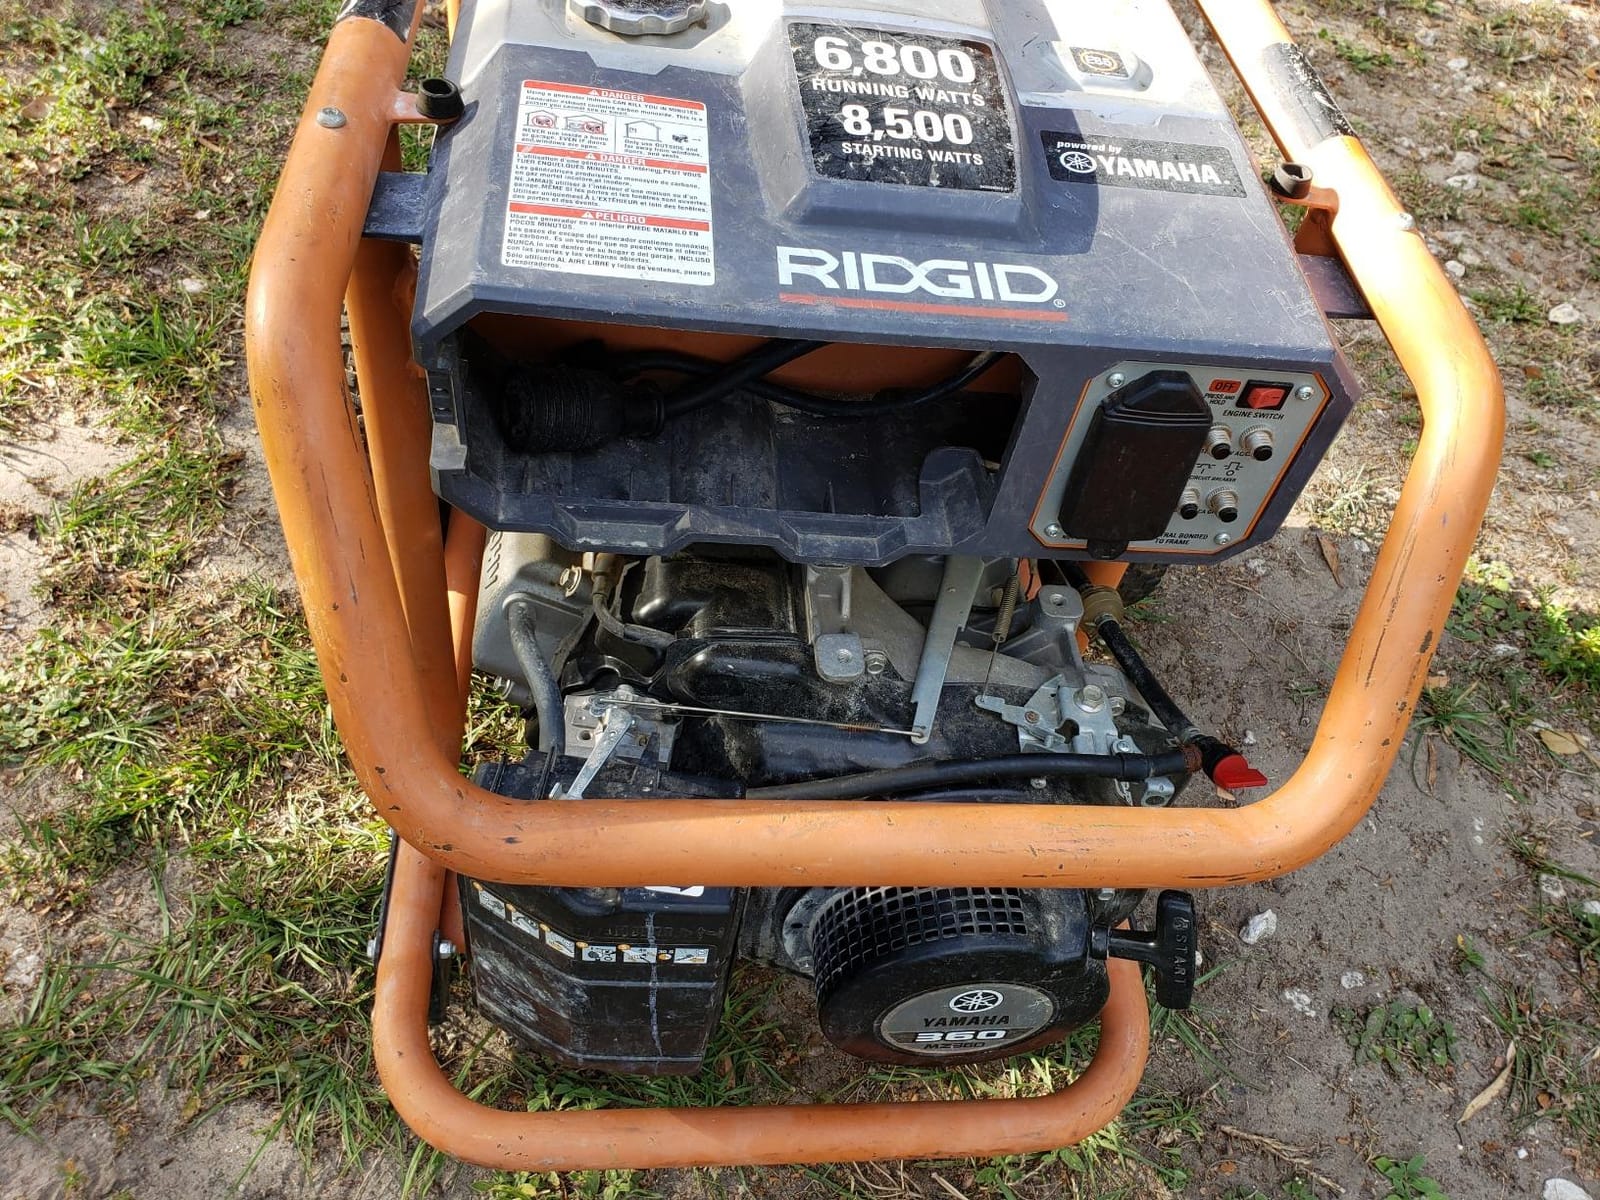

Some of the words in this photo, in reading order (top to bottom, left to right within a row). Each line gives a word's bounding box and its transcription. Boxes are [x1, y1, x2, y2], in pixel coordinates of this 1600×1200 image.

[814, 36, 976, 84] 6,800
[601, 90, 644, 102] DANGER
[812, 77, 910, 99] RUNNING
[915, 86, 986, 107] WATTS
[841, 104, 974, 146] 8,500
[841, 141, 927, 162] STARTING
[930, 147, 984, 167] WATTS
[1056, 139, 1105, 153] powered
[1107, 143, 1122, 155] by
[599, 153, 645, 165] DANGER
[1097, 155, 1220, 185] YAMAHA
[595, 211, 645, 224] PELIGRO
[776, 246, 1059, 303] RIDGID
[1214, 382, 1235, 391] OFF
[1222, 409, 1253, 418] ENGINE
[1253, 411, 1285, 420] SWITCH
[1178, 532, 1209, 540] BONDED
[1173, 934, 1188, 986] START
[923, 1015, 1010, 1028] YAMAHA
[914, 1029, 1007, 1043] 360
[924, 1041, 986, 1050] MZ360
